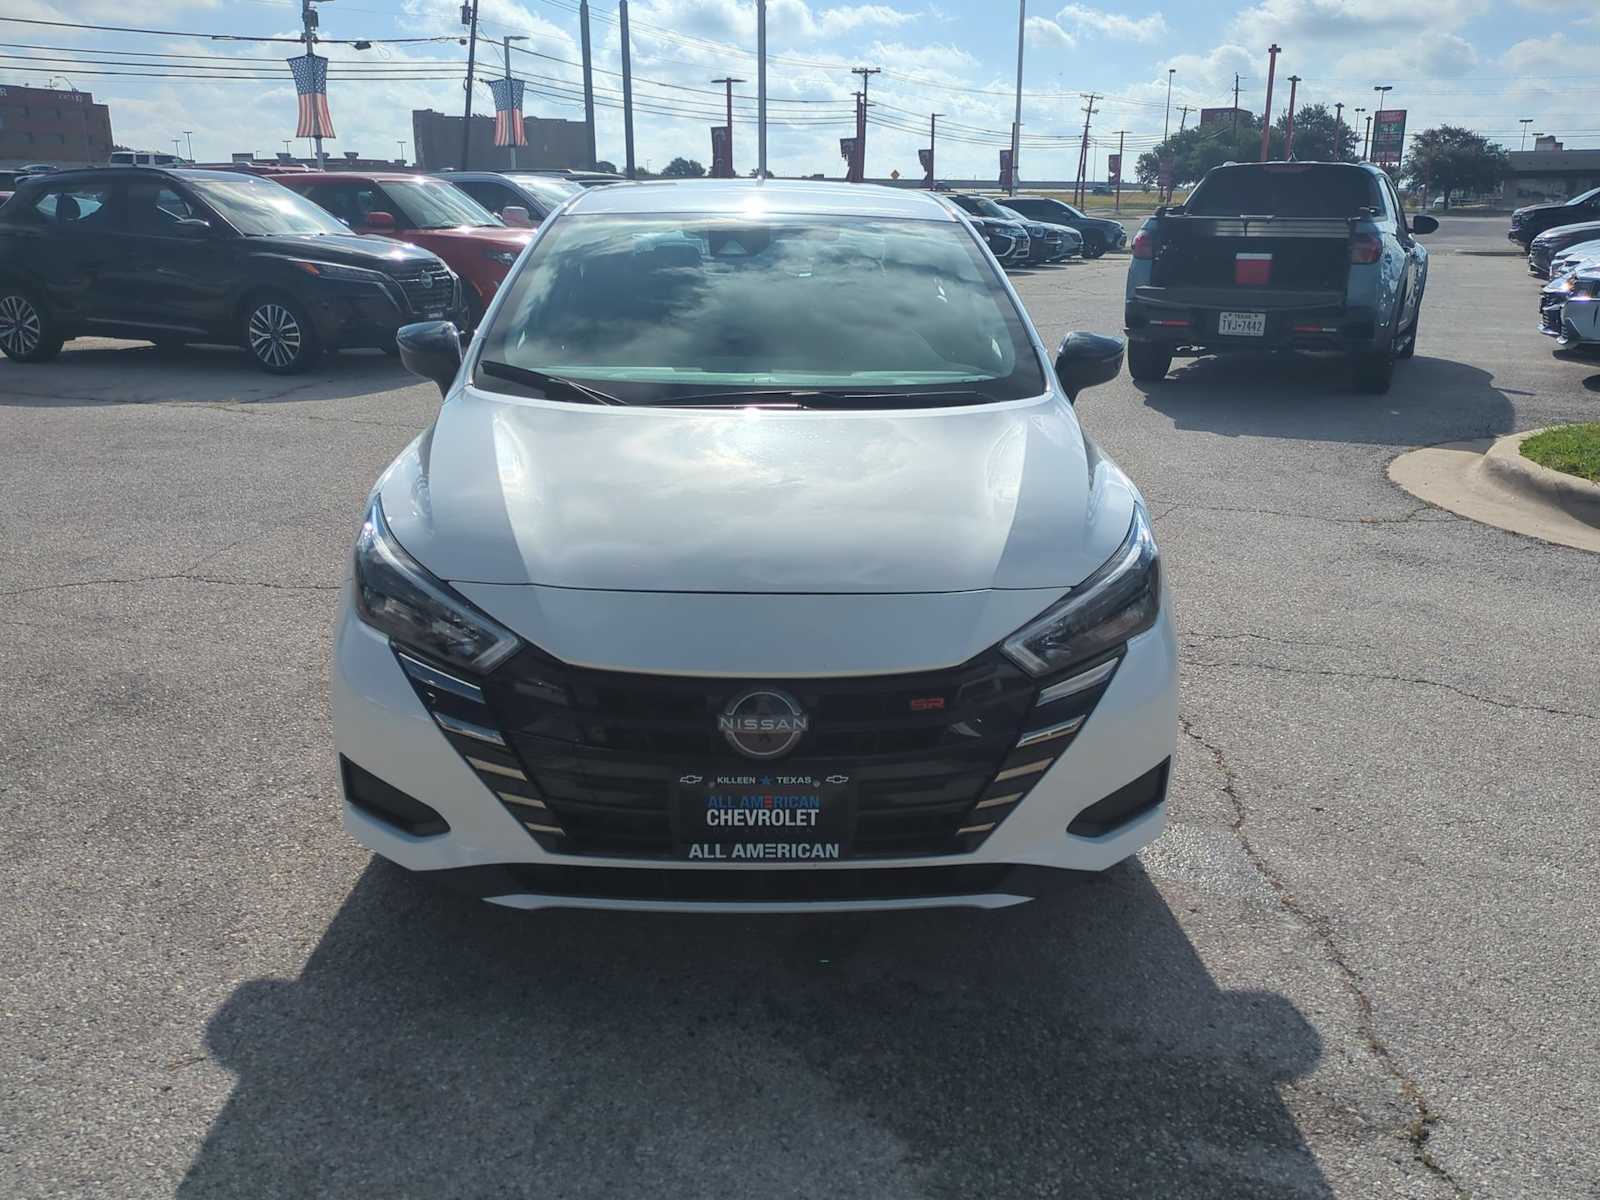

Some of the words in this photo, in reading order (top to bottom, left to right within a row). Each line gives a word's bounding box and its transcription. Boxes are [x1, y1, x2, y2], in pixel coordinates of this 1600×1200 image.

[912, 698, 944, 710] SR
[719, 717, 807, 731] NISSAN
[717, 776, 756, 784] KILLEEN
[776, 776, 812, 784] TEXAS
[708, 795, 736, 808] ALL
[740, 795, 820, 808] AMERICAN
[706, 809, 819, 826] CHEVROLET
[689, 843, 727, 859] ALL
[731, 843, 839, 859] AMERICAN
